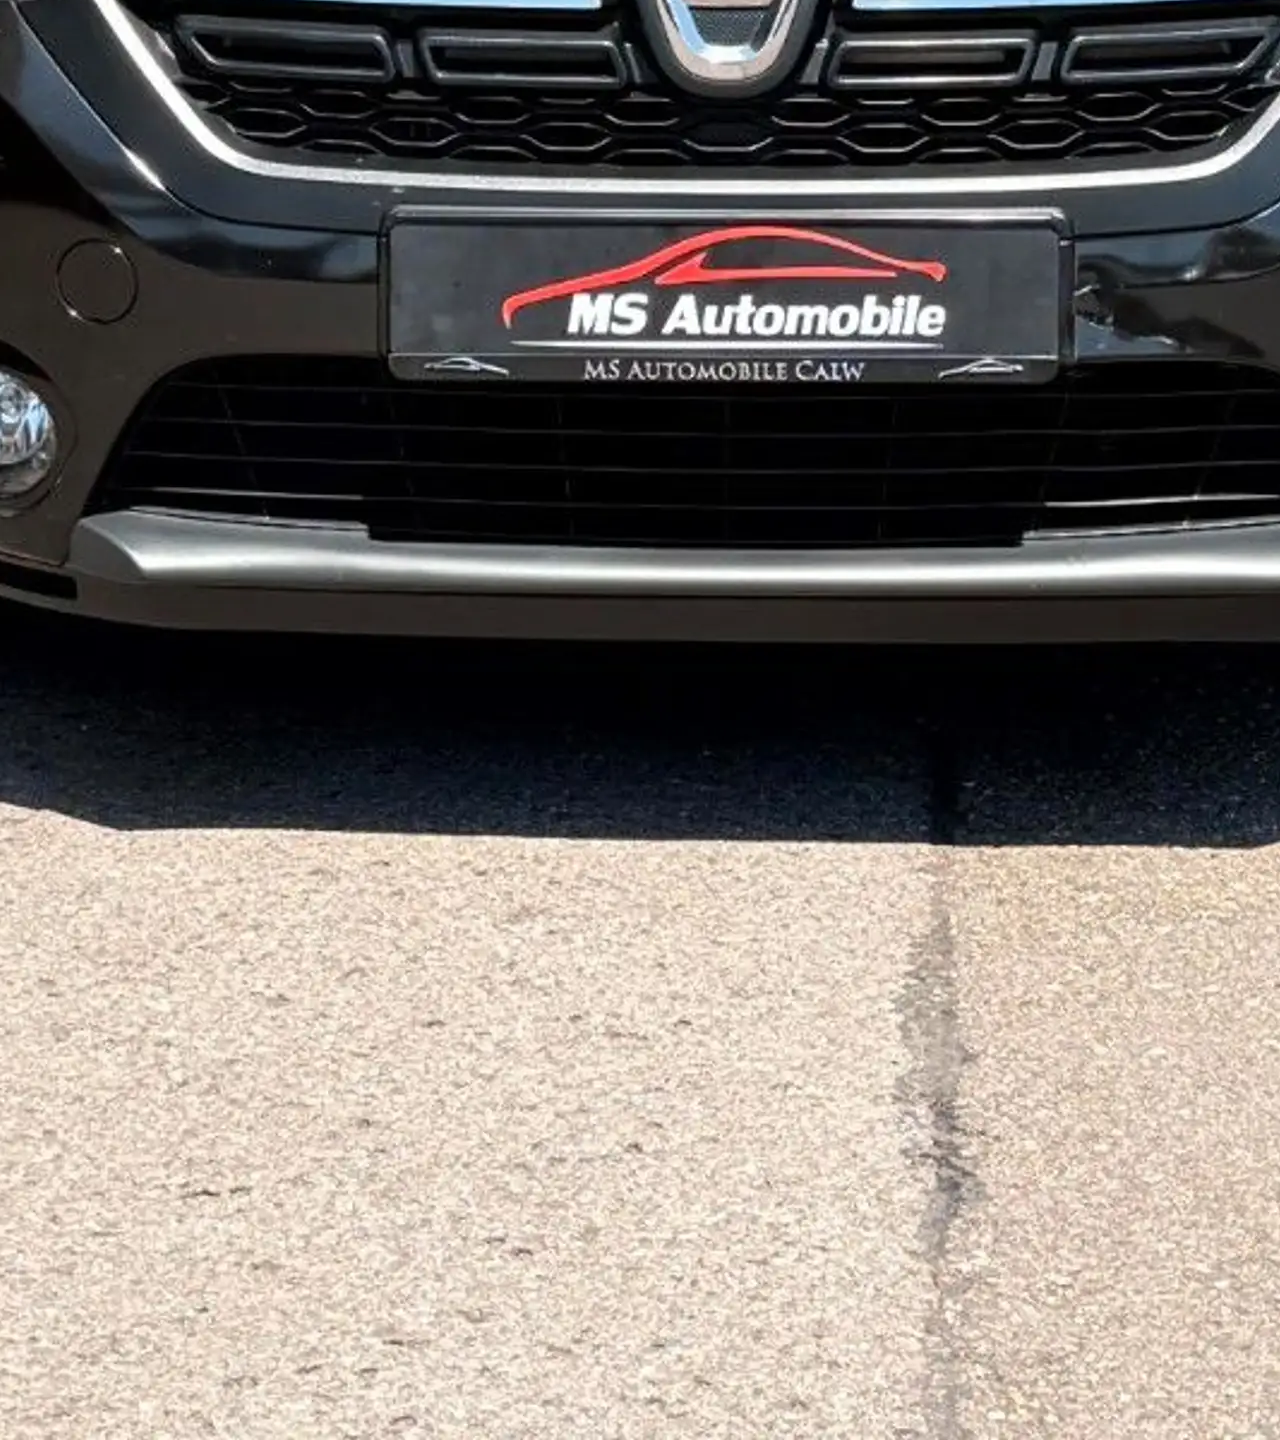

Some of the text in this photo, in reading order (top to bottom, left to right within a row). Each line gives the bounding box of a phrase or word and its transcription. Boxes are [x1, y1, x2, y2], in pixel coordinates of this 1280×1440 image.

[567, 292, 947, 337] MS Automobile
[583, 361, 620, 381] MS
